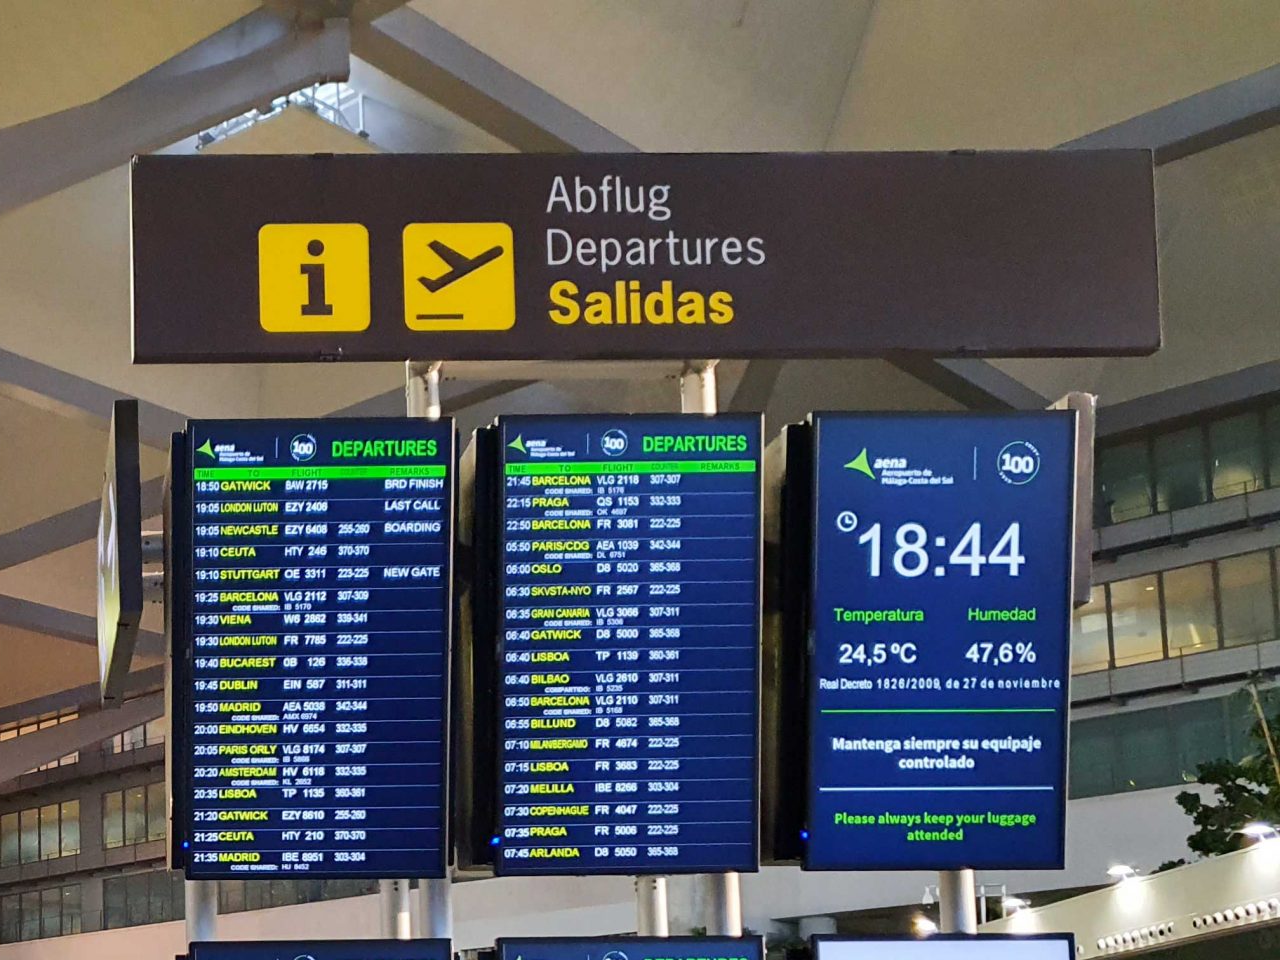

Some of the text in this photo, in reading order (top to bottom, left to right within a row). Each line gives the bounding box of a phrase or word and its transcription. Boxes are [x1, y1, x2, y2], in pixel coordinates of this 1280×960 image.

[546, 175, 671, 221] Abflug
[546, 227, 766, 272] Departures
[549, 280, 734, 325] Salidas
[292, 440, 438, 458] 100 DEPARTURES
[642, 435, 747, 452] DEPARTURES
[874, 457, 907, 469] aena
[1001, 453, 1034, 474] 100
[196, 479, 444, 492] 18:50 GATWICK BAW 2715 BRD FINISH
[507, 474, 639, 487] 21:45 BARCELONA VLG 2118
[221, 500, 440, 512] LONDON LUTON LAST CALL
[532, 498, 569, 508] PRAGA
[221, 523, 441, 535] NEWCASTLE BOARDING
[532, 541, 589, 552] PARIS/CDG
[858, 522, 1026, 577] 18:44
[220, 548, 256, 558] CEUTA
[220, 567, 440, 580] STUTTGART NEW GATE
[532, 564, 562, 574] OSLO
[220, 592, 278, 602] BARCELONA
[220, 615, 251, 624] VIENA
[834, 608, 1036, 624] Temperatura Humedad
[220, 658, 276, 668] BUCAREST
[531, 652, 569, 662] LISBOA
[220, 680, 258, 690] DUBLIN
[531, 674, 570, 684] BILBAO
[820, 678, 1060, 690] Real Decreto 1826/2009, de 27 de noviembre
[219, 702, 261, 712] MADRID
[219, 724, 277, 734] EINDHOVEN
[531, 718, 576, 729] BILLUND
[219, 745, 276, 756] PARIS ORLY
[833, 737, 1041, 752] Mantenga siempre su equipaje
[898, 756, 975, 768] controlado
[219, 788, 256, 799] LISBOA
[219, 810, 268, 821] GATWICK
[835, 812, 1035, 827] Please always keep your luggage
[219, 832, 254, 842] CEUTA
[907, 829, 963, 841] attended
[530, 848, 579, 858] ARLANDA
